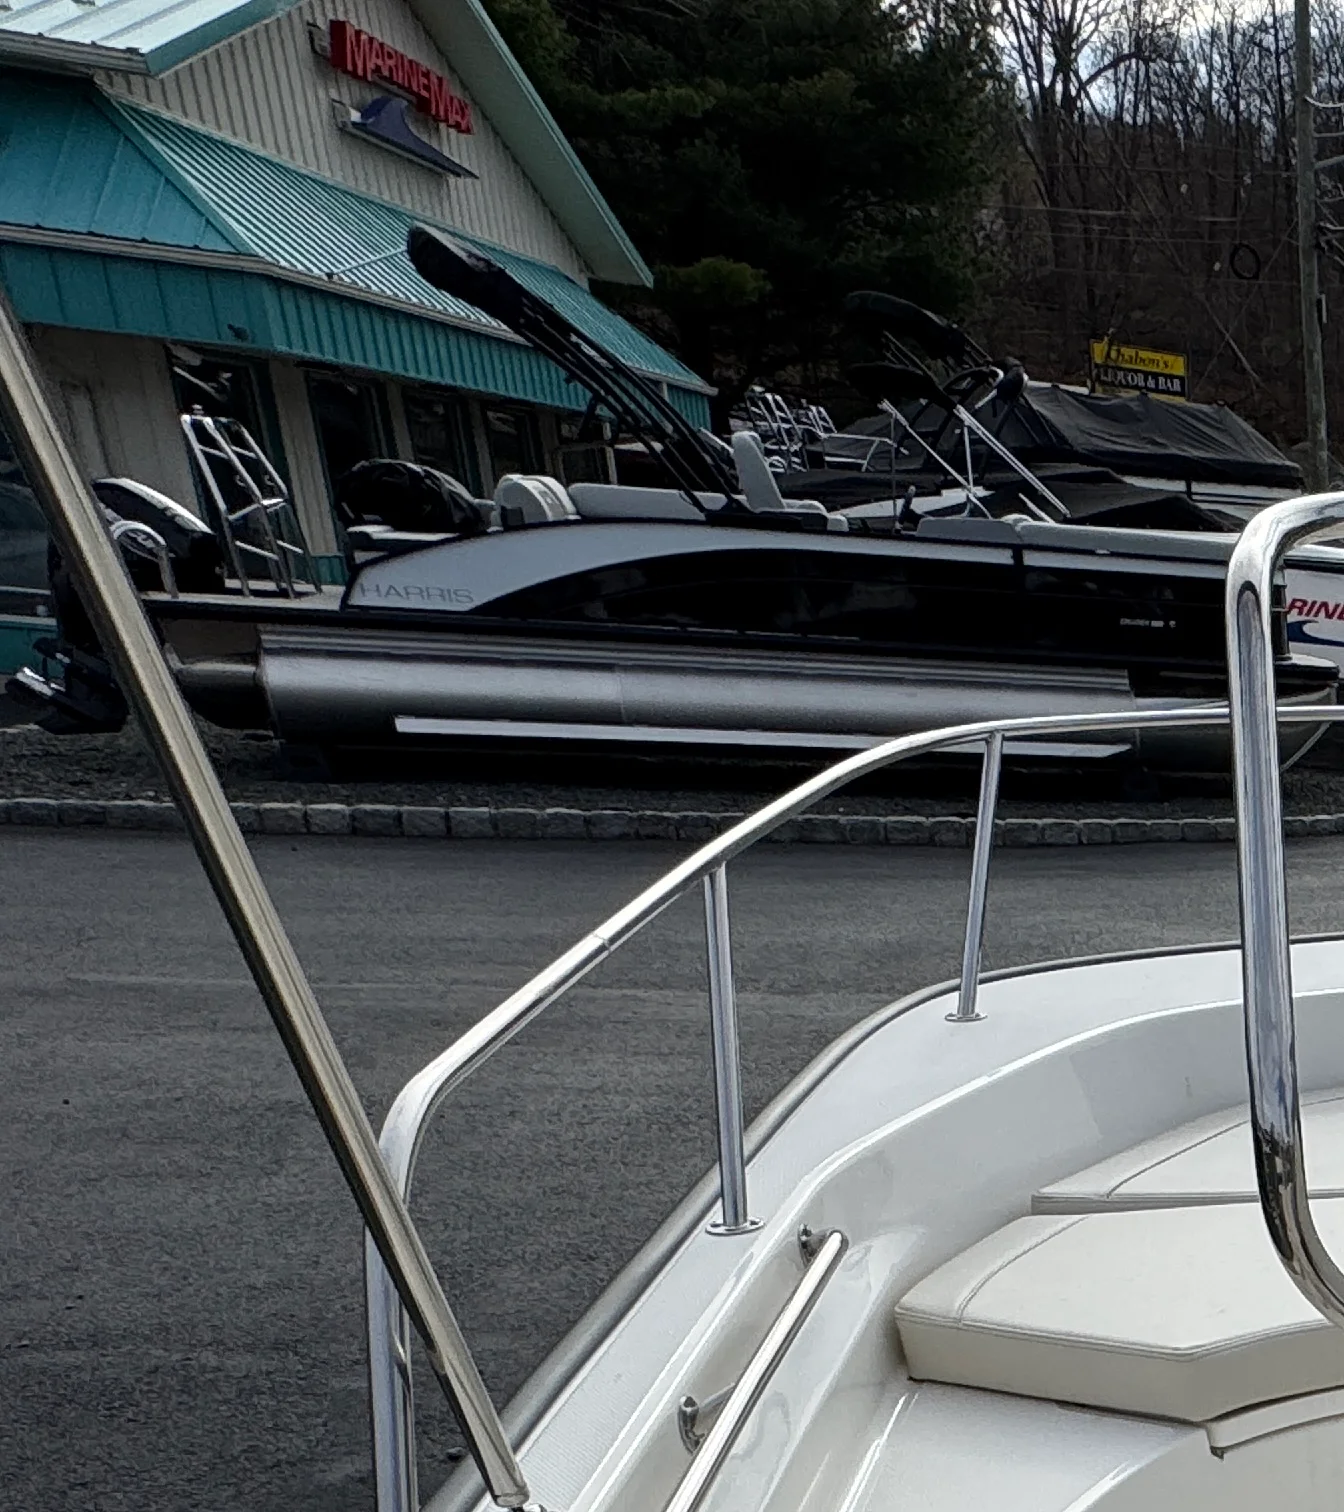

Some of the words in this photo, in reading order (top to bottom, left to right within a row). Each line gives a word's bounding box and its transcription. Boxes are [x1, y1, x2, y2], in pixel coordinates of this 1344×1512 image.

[1146, 375, 1156, 388] &
[1158, 376, 1182, 392] BAR
[359, 583, 474, 603] HARRIS
